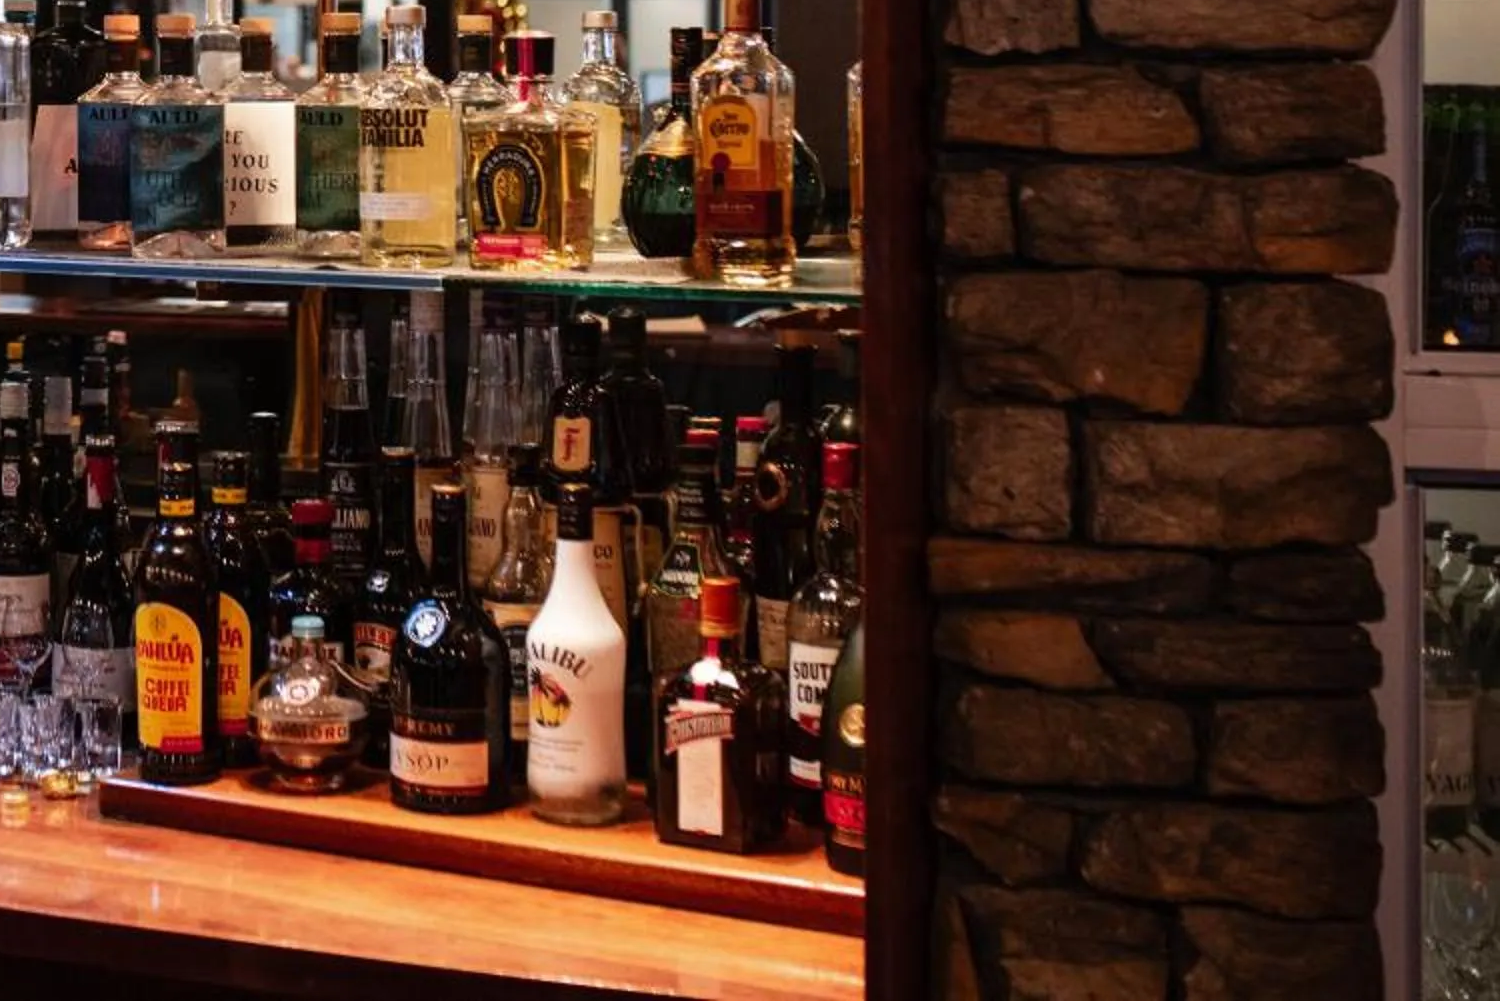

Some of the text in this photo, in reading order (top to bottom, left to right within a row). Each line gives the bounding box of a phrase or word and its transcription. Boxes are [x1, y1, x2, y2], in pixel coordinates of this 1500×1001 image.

[361, 108, 429, 129] BSOLUT
[231, 154, 269, 170] YOU
[225, 176, 279, 194] IOUS
[531, 641, 593, 680] ALIBU
[793, 662, 830, 681] SOUT
